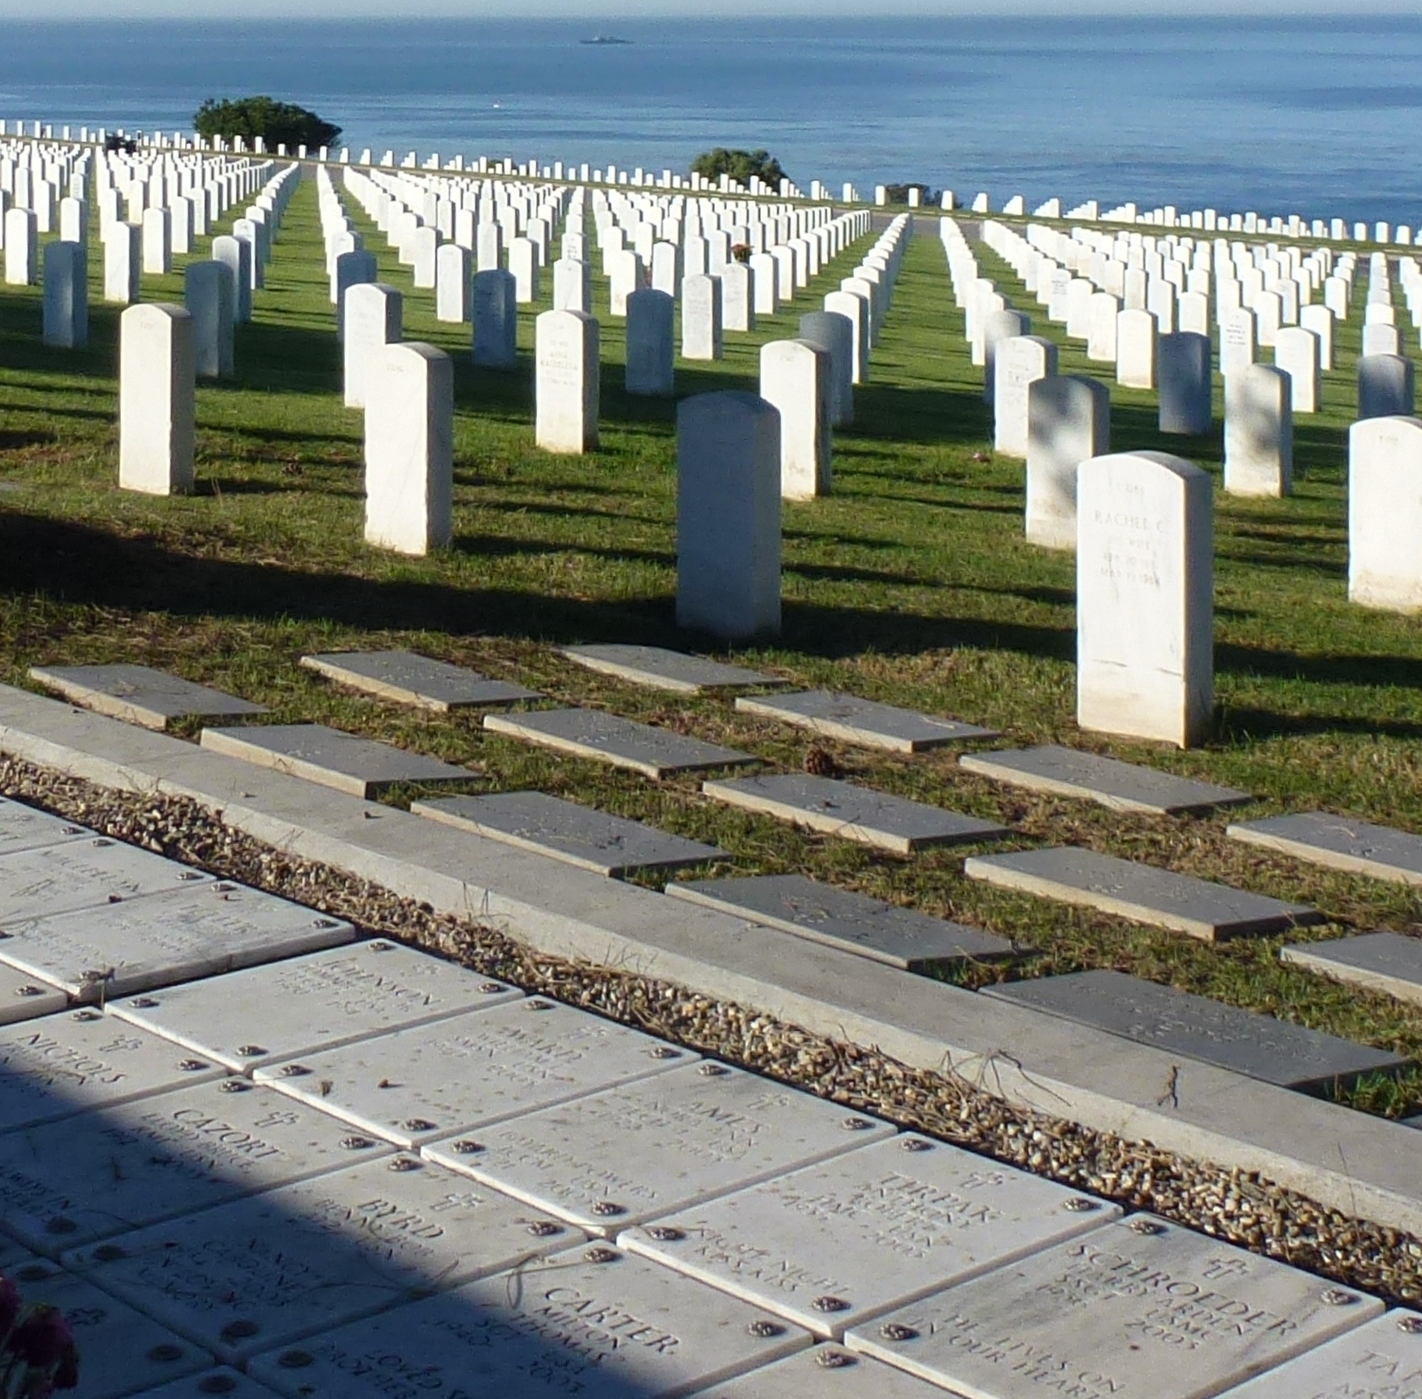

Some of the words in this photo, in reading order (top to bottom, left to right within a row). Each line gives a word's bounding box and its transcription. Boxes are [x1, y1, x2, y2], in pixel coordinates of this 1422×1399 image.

[315, 959, 446, 1006] JOHNSON
[14, 1032, 133, 1084] NICHOLS
[165, 1106, 288, 1161] CAZORT
[677, 1099, 775, 1135] AMES
[354, 1197, 451, 1241] BYRD
[1061, 1241, 1305, 1338] SCHROEDER
[537, 1284, 684, 1354] CARTER
[941, 1333, 1012, 1364] OUR
[991, 1335, 1078, 1374] LIVES
